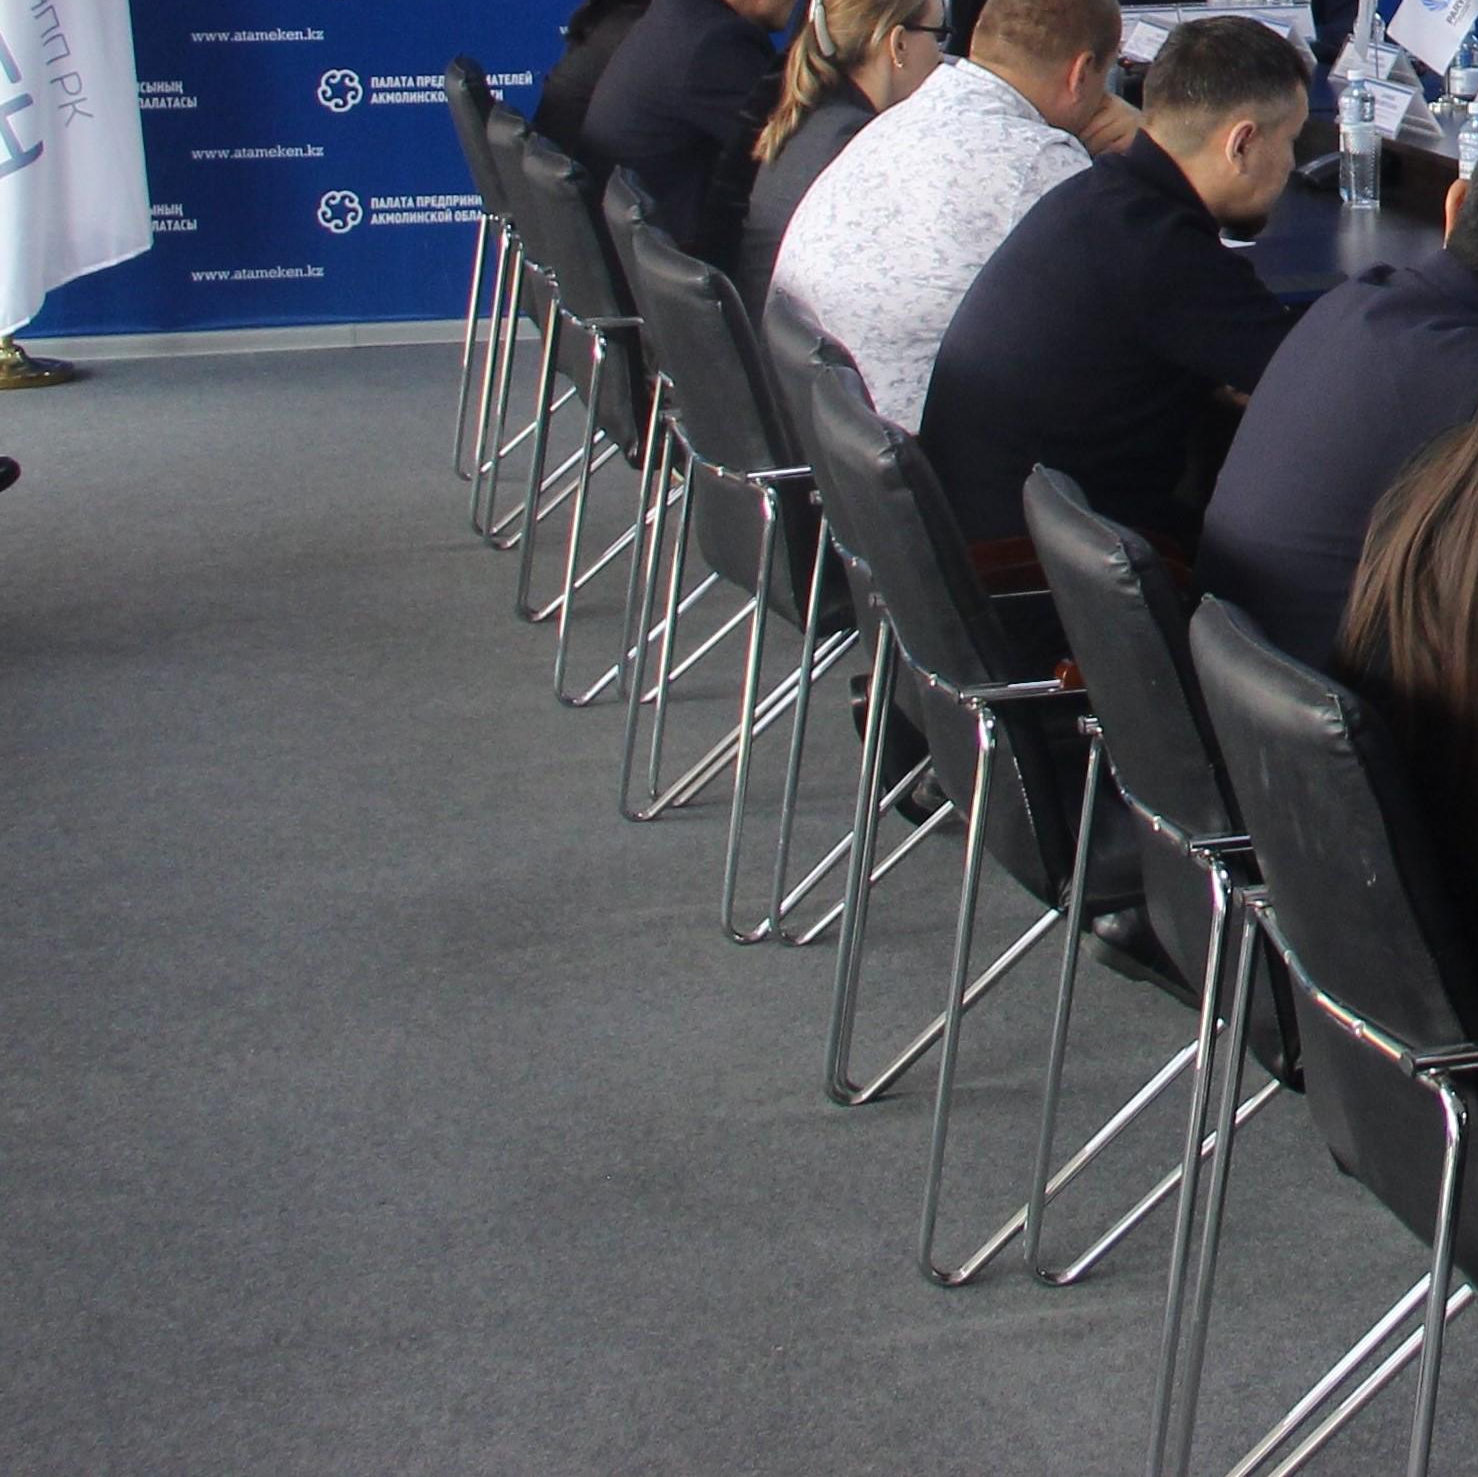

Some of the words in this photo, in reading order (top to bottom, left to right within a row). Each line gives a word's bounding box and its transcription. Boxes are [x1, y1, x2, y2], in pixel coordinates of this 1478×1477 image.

[190, 27, 325, 43] www.atameken.kz
[371, 75, 415, 89] ПАЛАТА
[49, 71, 95, 128] РК
[370, 90, 448, 104] АКМОЛИНСКО
[190, 144, 325, 160] www.atameken.kz
[370, 196, 415, 210] ПАЛАТА
[416, 194, 482, 208] ПРЕДПРИНИ
[370, 208, 453, 225] АКМОЛИНСКОЙ
[190, 264, 325, 282] www.atameken.kz
